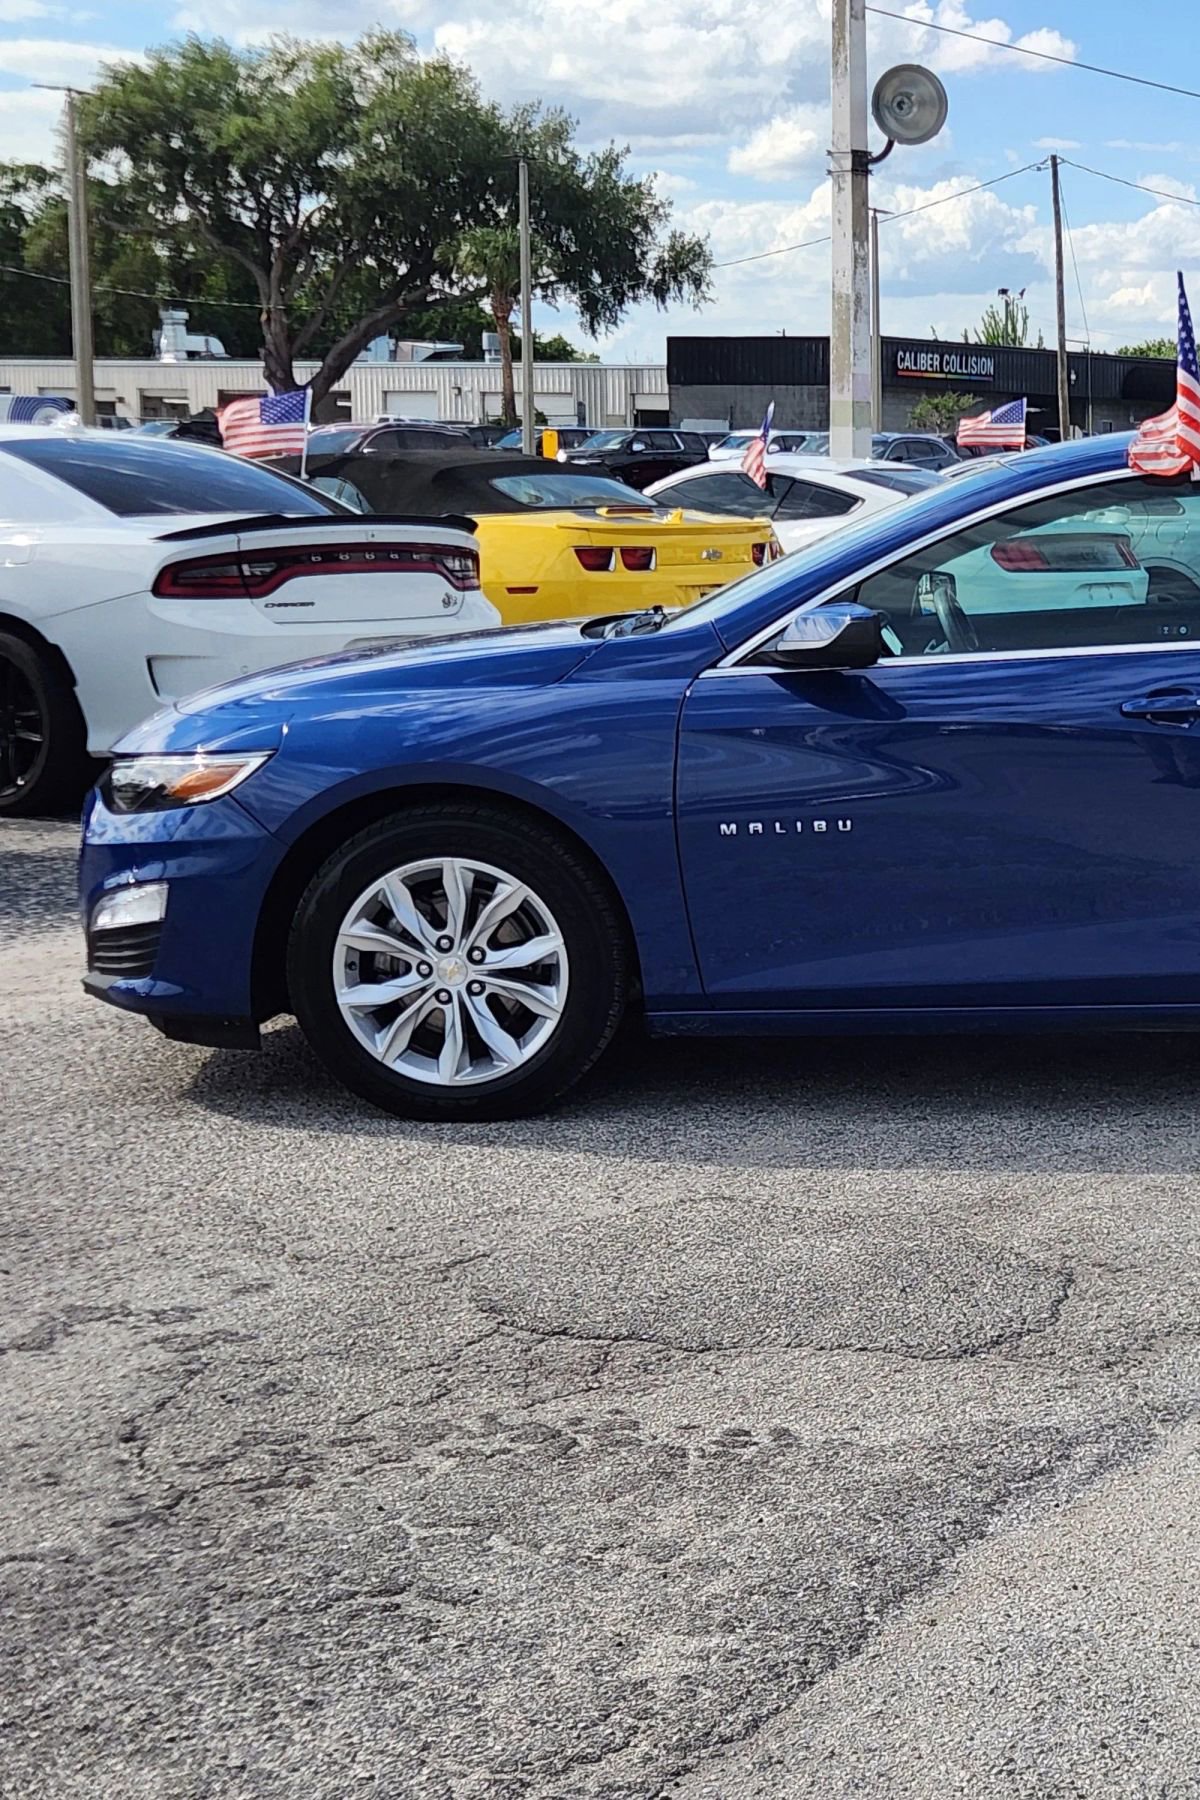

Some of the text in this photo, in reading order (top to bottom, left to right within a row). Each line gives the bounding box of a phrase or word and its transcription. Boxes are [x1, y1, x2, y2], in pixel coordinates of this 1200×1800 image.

[897, 350, 994, 375] CALIBER COLLISION
[719, 819, 852, 836] MALIBU
